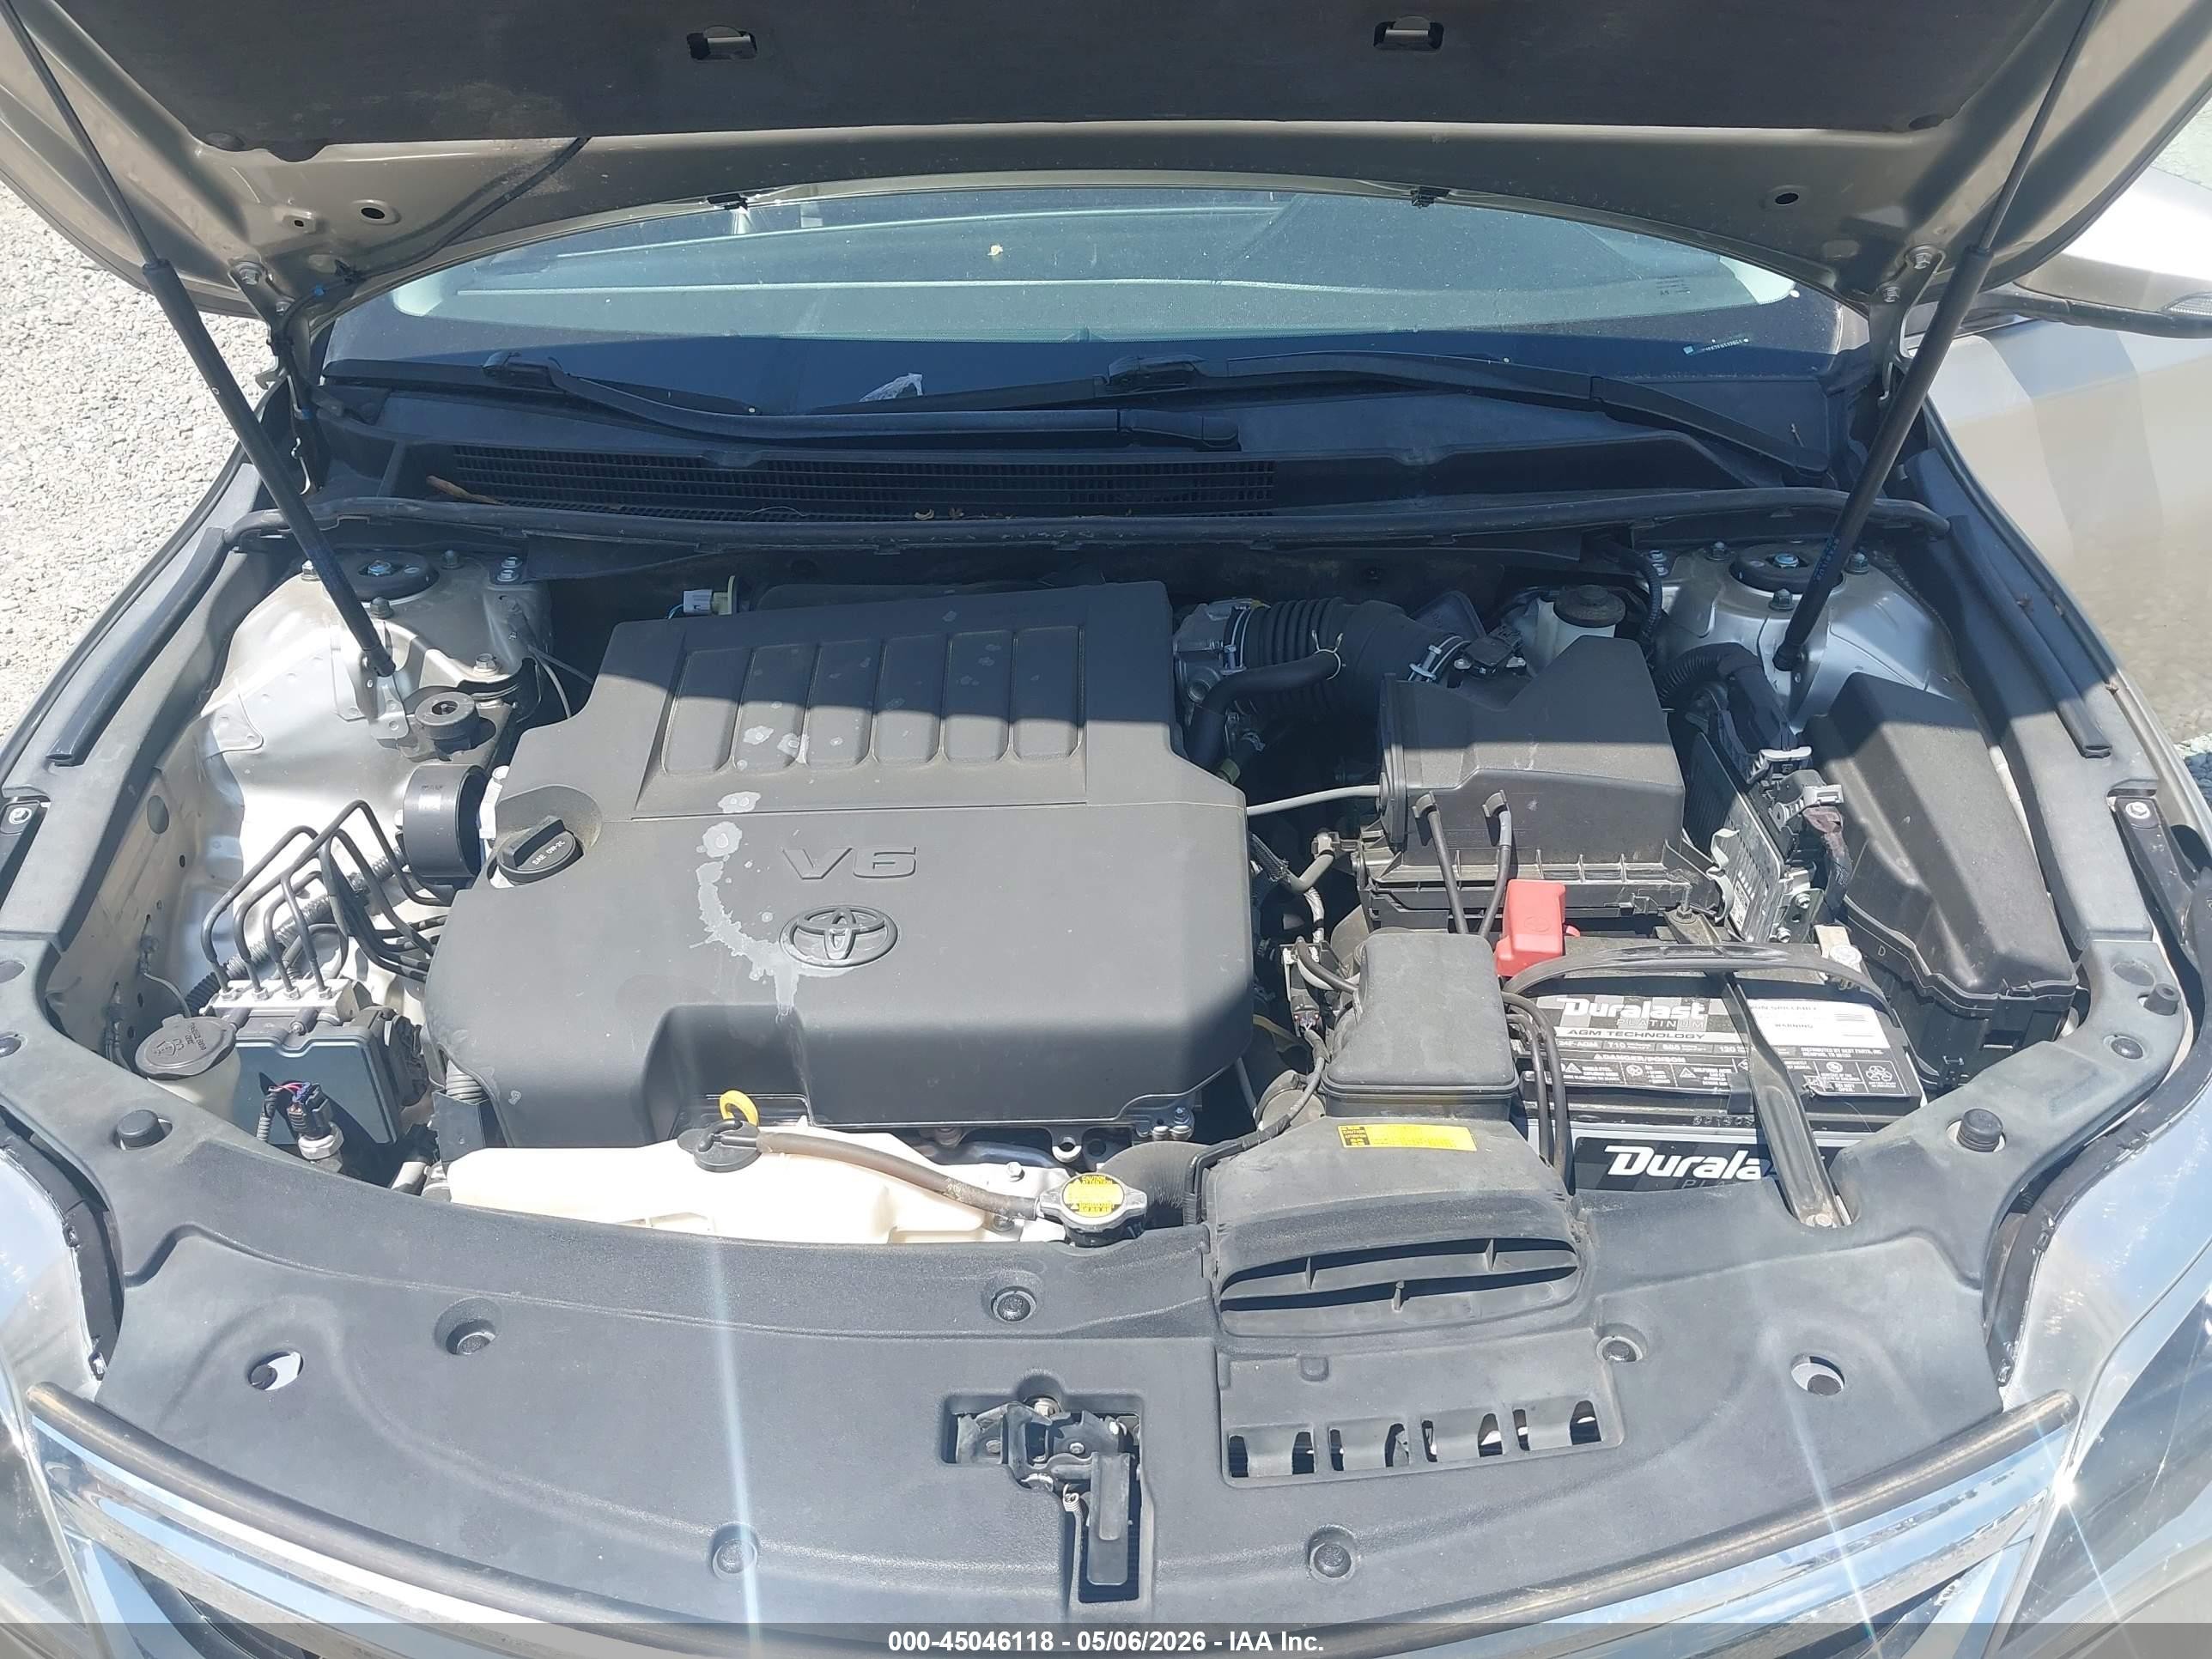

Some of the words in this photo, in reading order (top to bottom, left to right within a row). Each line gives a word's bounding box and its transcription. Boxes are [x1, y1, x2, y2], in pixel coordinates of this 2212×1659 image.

[781, 846, 918, 881] V6
[1556, 997, 1706, 1020] Duralast
[1608, 1030, 1706, 1040] TECHNOLOGY
[1616, 1018, 1705, 1029] PLATINUM
[1603, 1145, 1776, 1180] Durala
